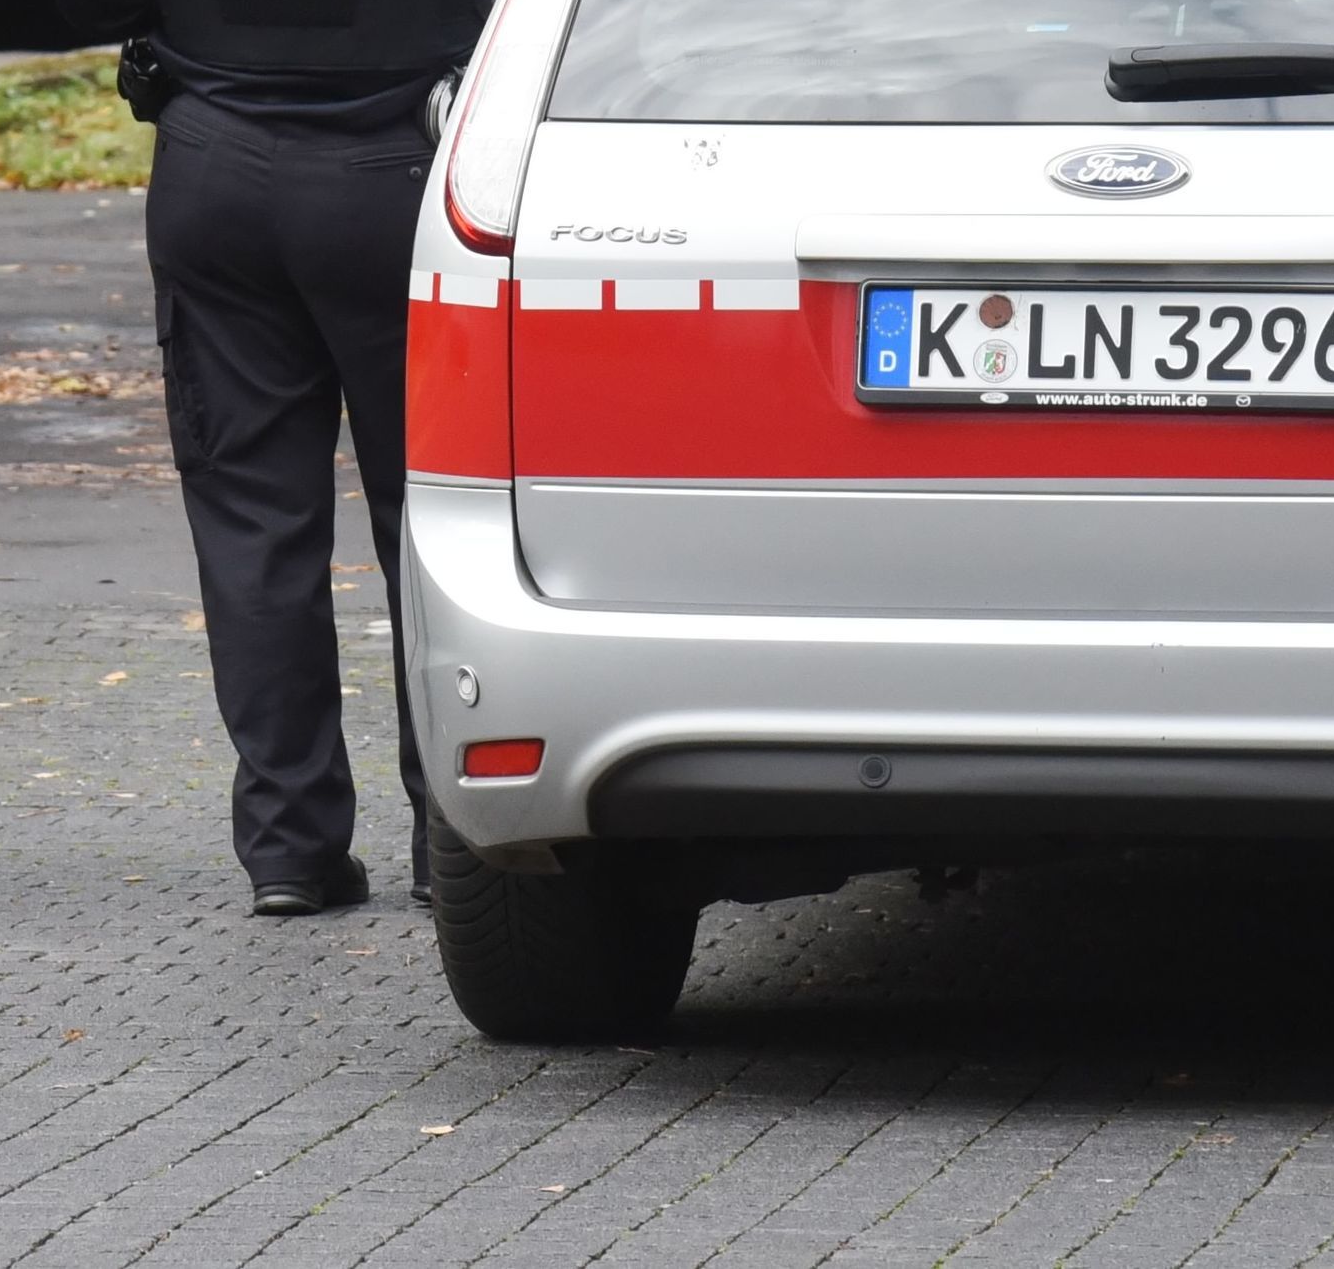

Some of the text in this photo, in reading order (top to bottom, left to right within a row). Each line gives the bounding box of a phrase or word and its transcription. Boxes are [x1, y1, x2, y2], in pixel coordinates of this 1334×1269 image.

[1077, 153, 1158, 183] Ford
[550, 225, 688, 245] FOCUS
[918, 302, 970, 378] K
[1027, 303, 1135, 380] LN
[879, 350, 896, 373] D
